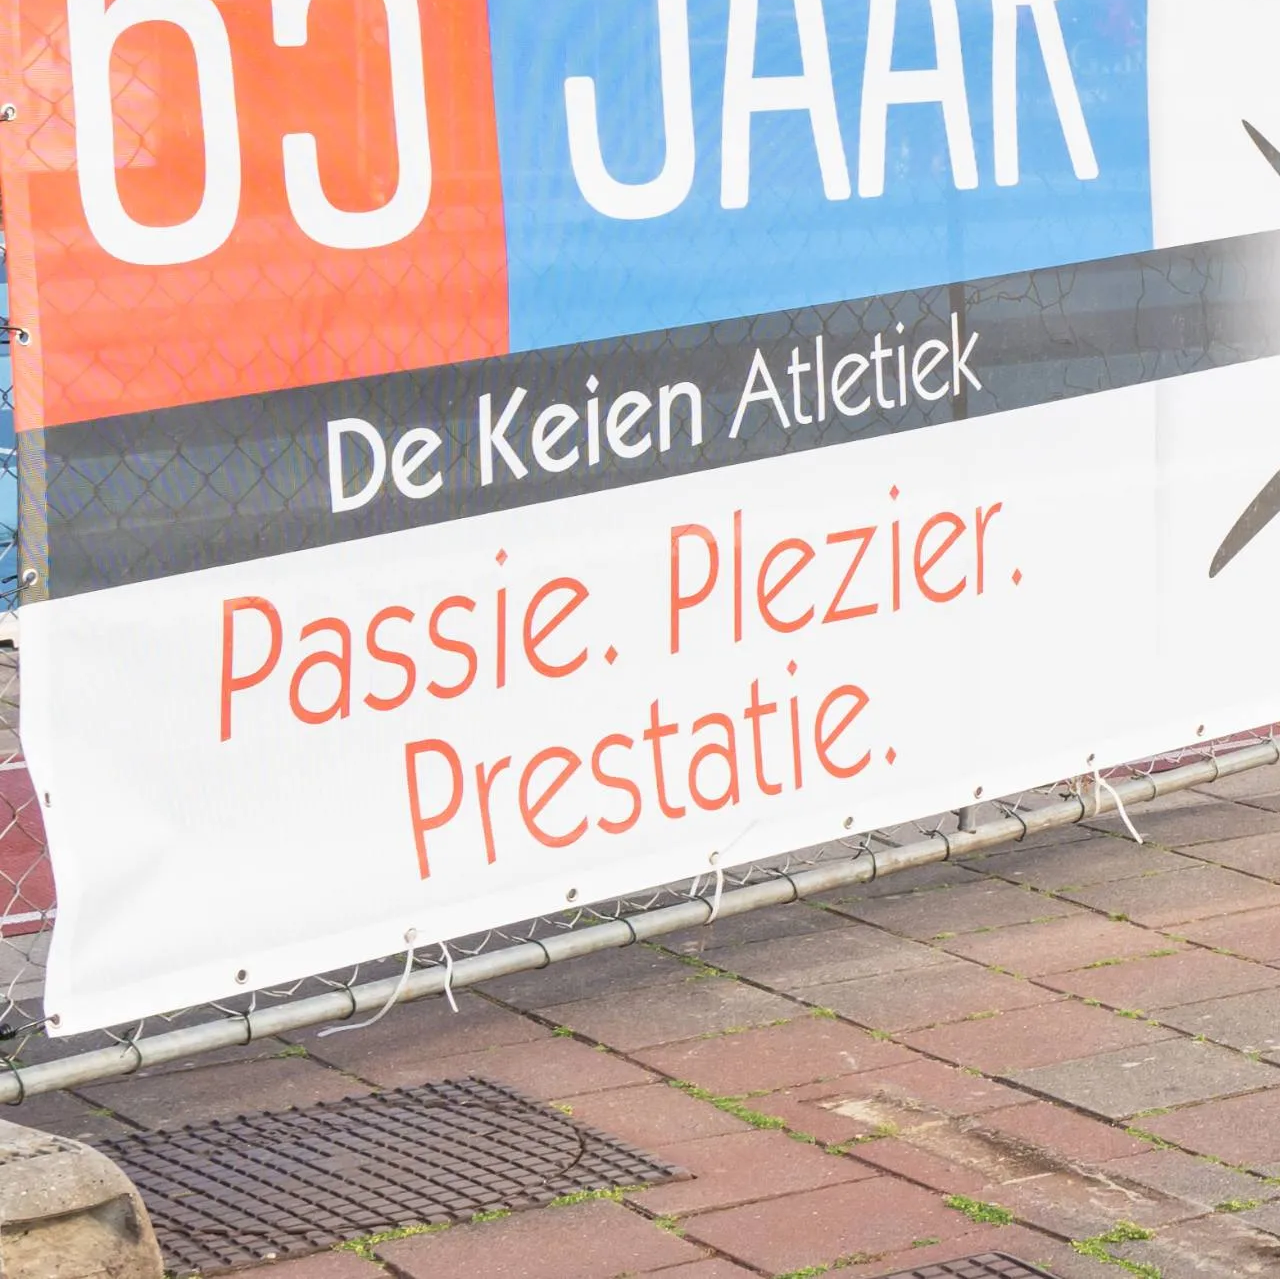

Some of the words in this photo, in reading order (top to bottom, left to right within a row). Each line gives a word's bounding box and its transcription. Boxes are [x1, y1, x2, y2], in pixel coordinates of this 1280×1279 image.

[326, 415, 444, 514] De
[478, 373, 705, 491] Keien
[727, 311, 983, 442] Atletiek
[217, 548, 620, 742] Passie.
[668, 484, 1025, 657] Plezier.
[403, 661, 898, 881] Prestatie.
